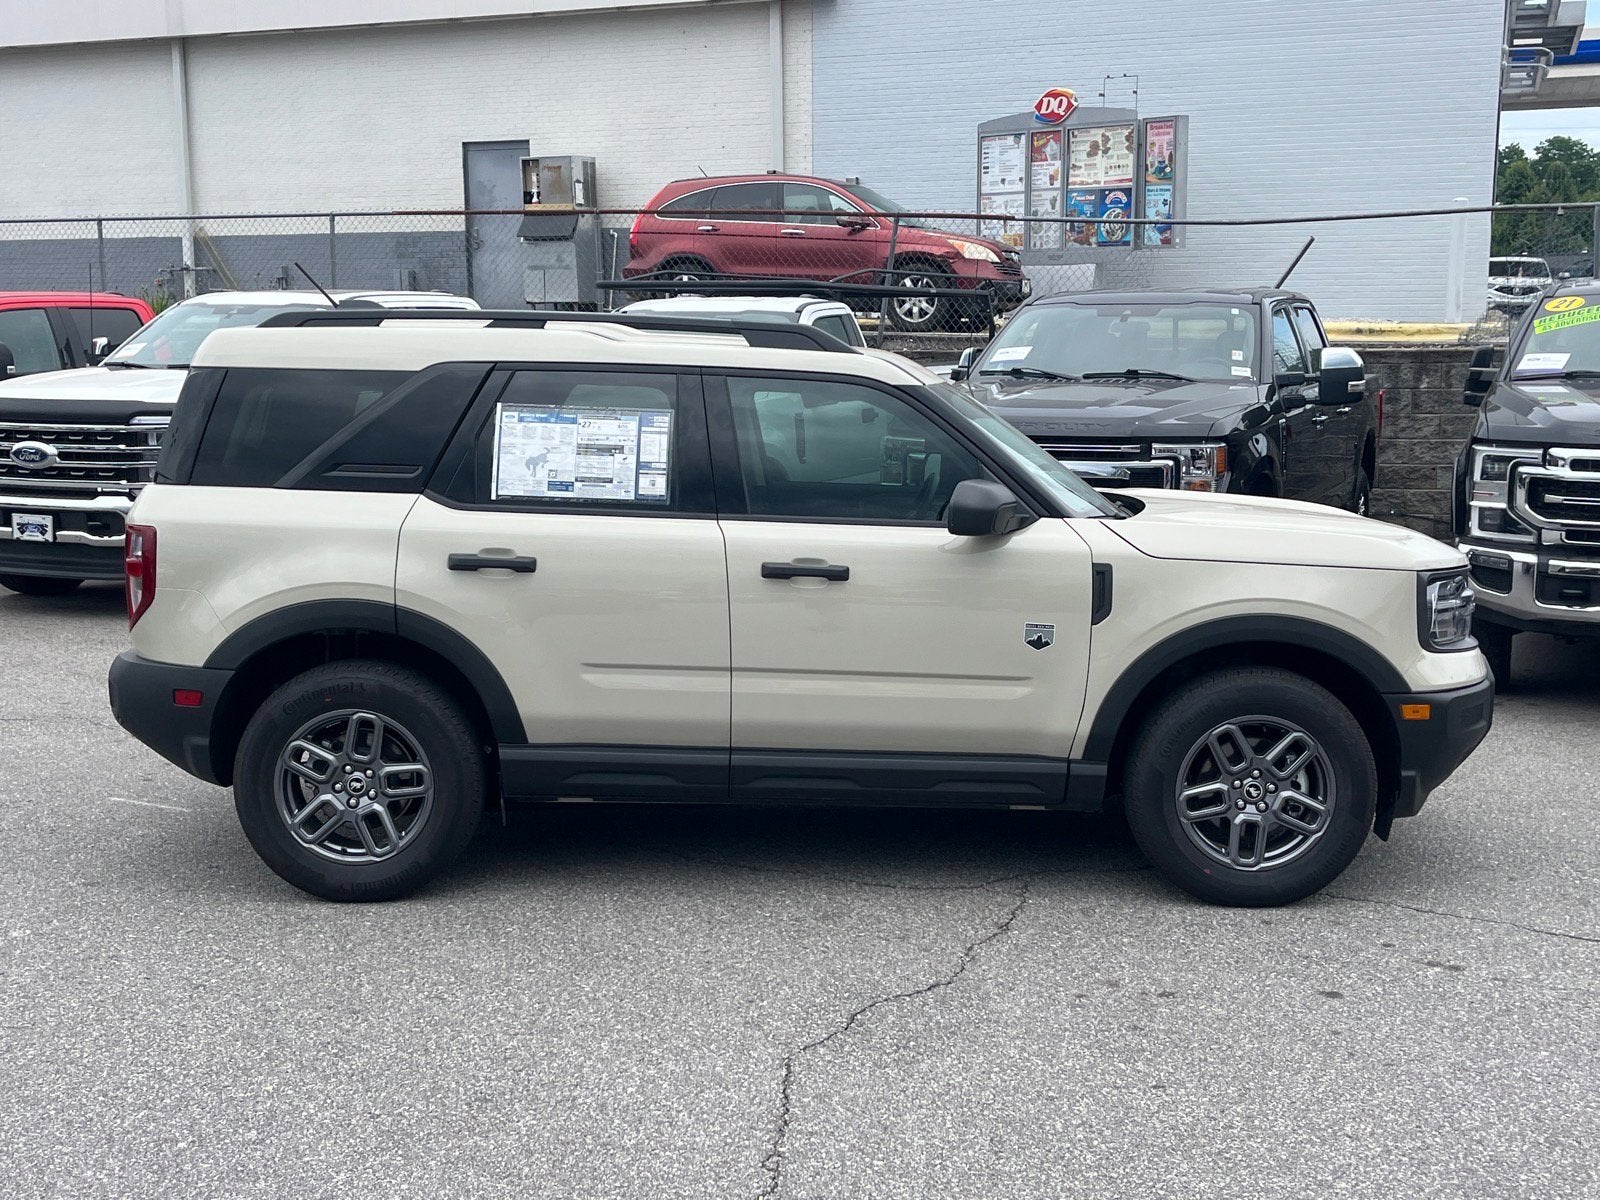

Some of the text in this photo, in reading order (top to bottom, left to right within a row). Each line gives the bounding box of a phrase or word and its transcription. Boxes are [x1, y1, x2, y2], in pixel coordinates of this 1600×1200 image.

[1040, 96, 1068, 116] DQ
[1552, 298, 1577, 309] 21
[1555, 313, 1600, 328] ADVERTISE
[19, 448, 41, 461] Ford
[283, 682, 354, 716] Continental
